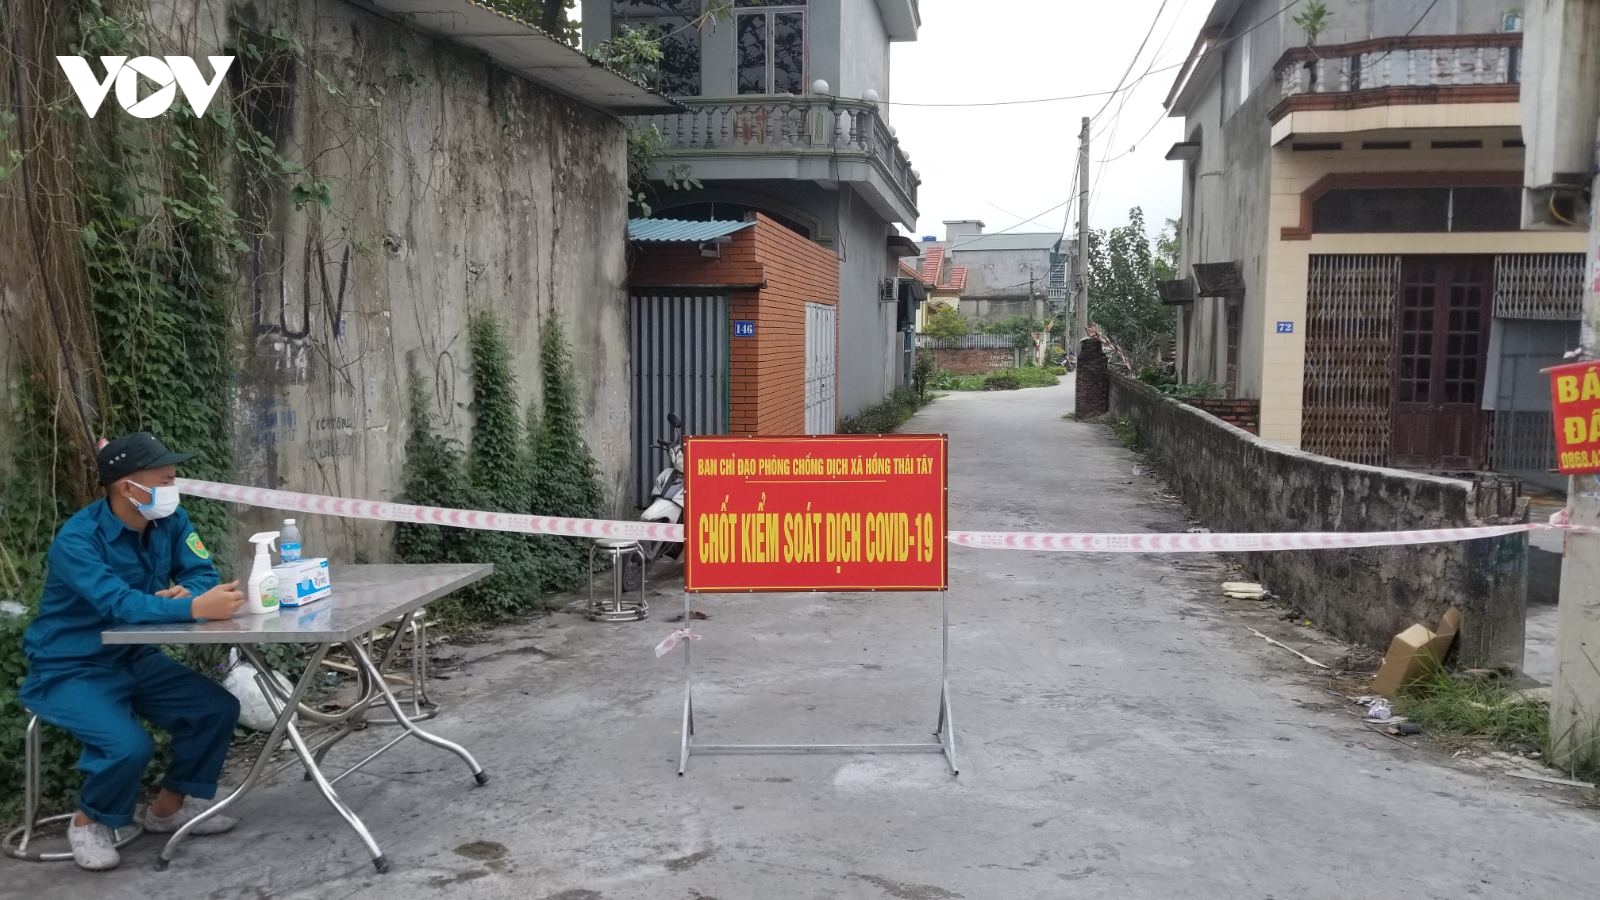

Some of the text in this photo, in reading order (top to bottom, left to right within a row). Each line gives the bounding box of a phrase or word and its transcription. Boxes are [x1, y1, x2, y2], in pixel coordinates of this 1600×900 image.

[736, 323, 753, 334] 146
[1279, 323, 1292, 332] 72
[697, 452, 934, 479] BAN CHỈ ĐẠO PHÒNG CHỐNG DỊCH XÃ HỒNG THÁI TÂY
[698, 491, 935, 574] CHỐT KIỂM SOÁT DỊCH COVID-19
